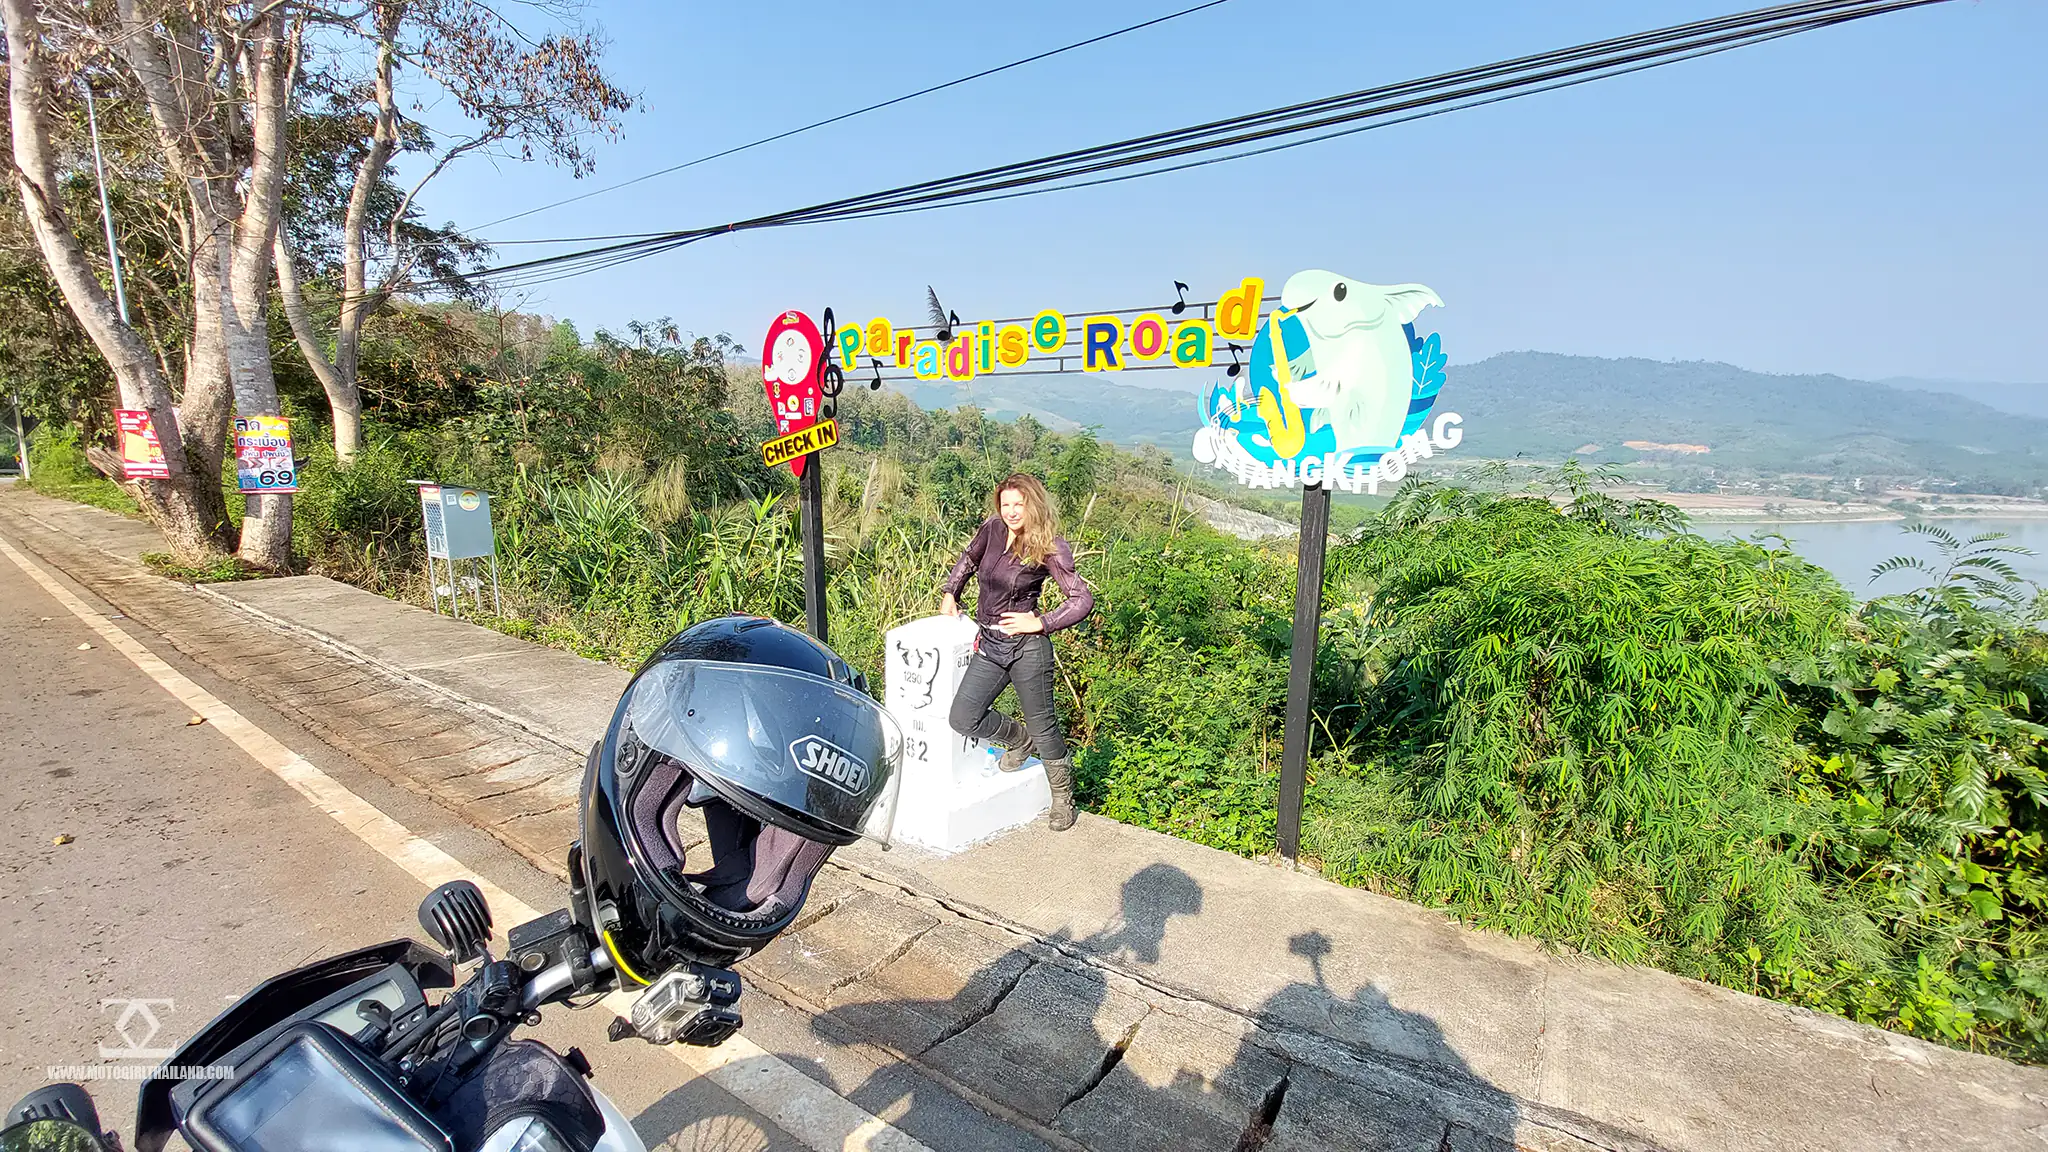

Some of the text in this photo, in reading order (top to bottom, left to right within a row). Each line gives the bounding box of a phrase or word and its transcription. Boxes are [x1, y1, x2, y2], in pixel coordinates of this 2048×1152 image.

[837, 280, 1261, 379] Paradise Road
[765, 424, 835, 463] CHECK IN
[259, 470, 294, 486] 69
[801, 741, 866, 791] SHOEI
